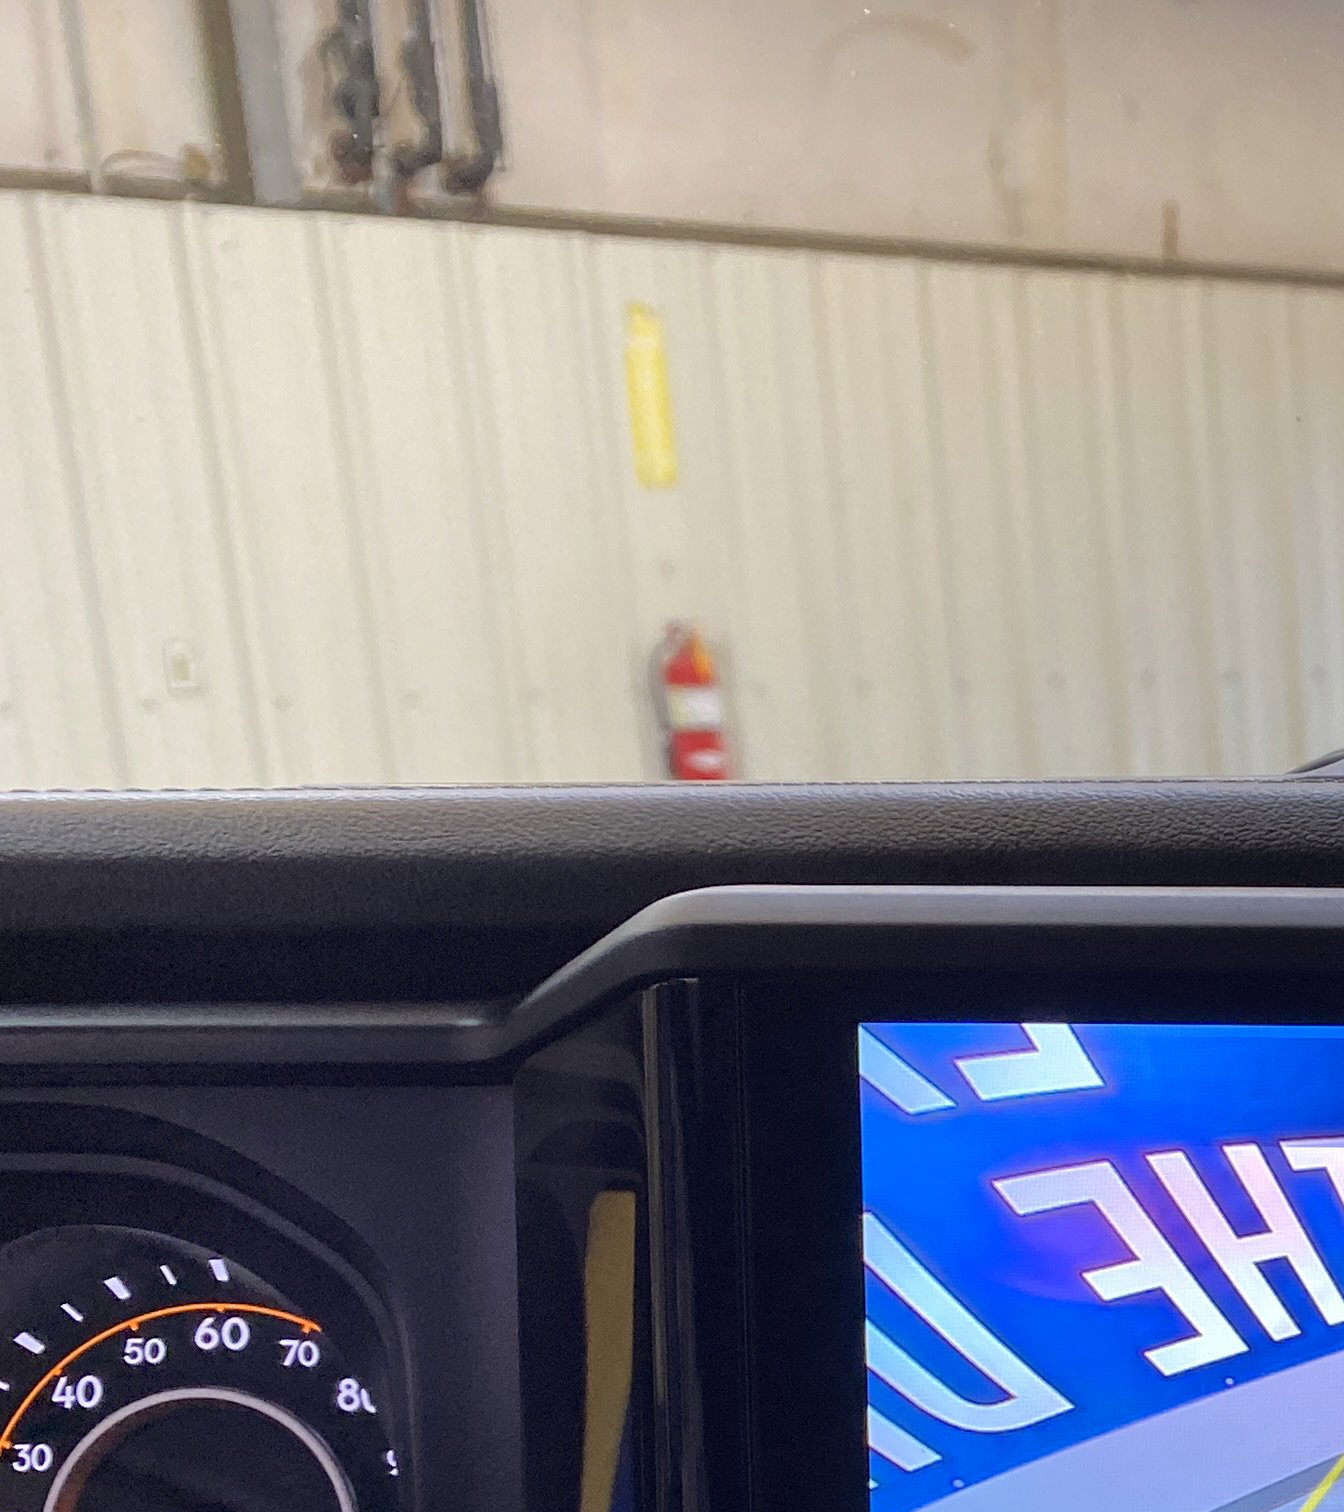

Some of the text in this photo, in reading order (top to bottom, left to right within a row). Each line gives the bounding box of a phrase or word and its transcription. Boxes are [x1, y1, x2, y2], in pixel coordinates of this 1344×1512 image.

[194, 1316, 250, 1351] 60
[123, 1337, 166, 1365] 50
[279, 1338, 320, 1368] 70
[51, 1374, 103, 1409] 40
[12, 1443, 54, 1473] 30
